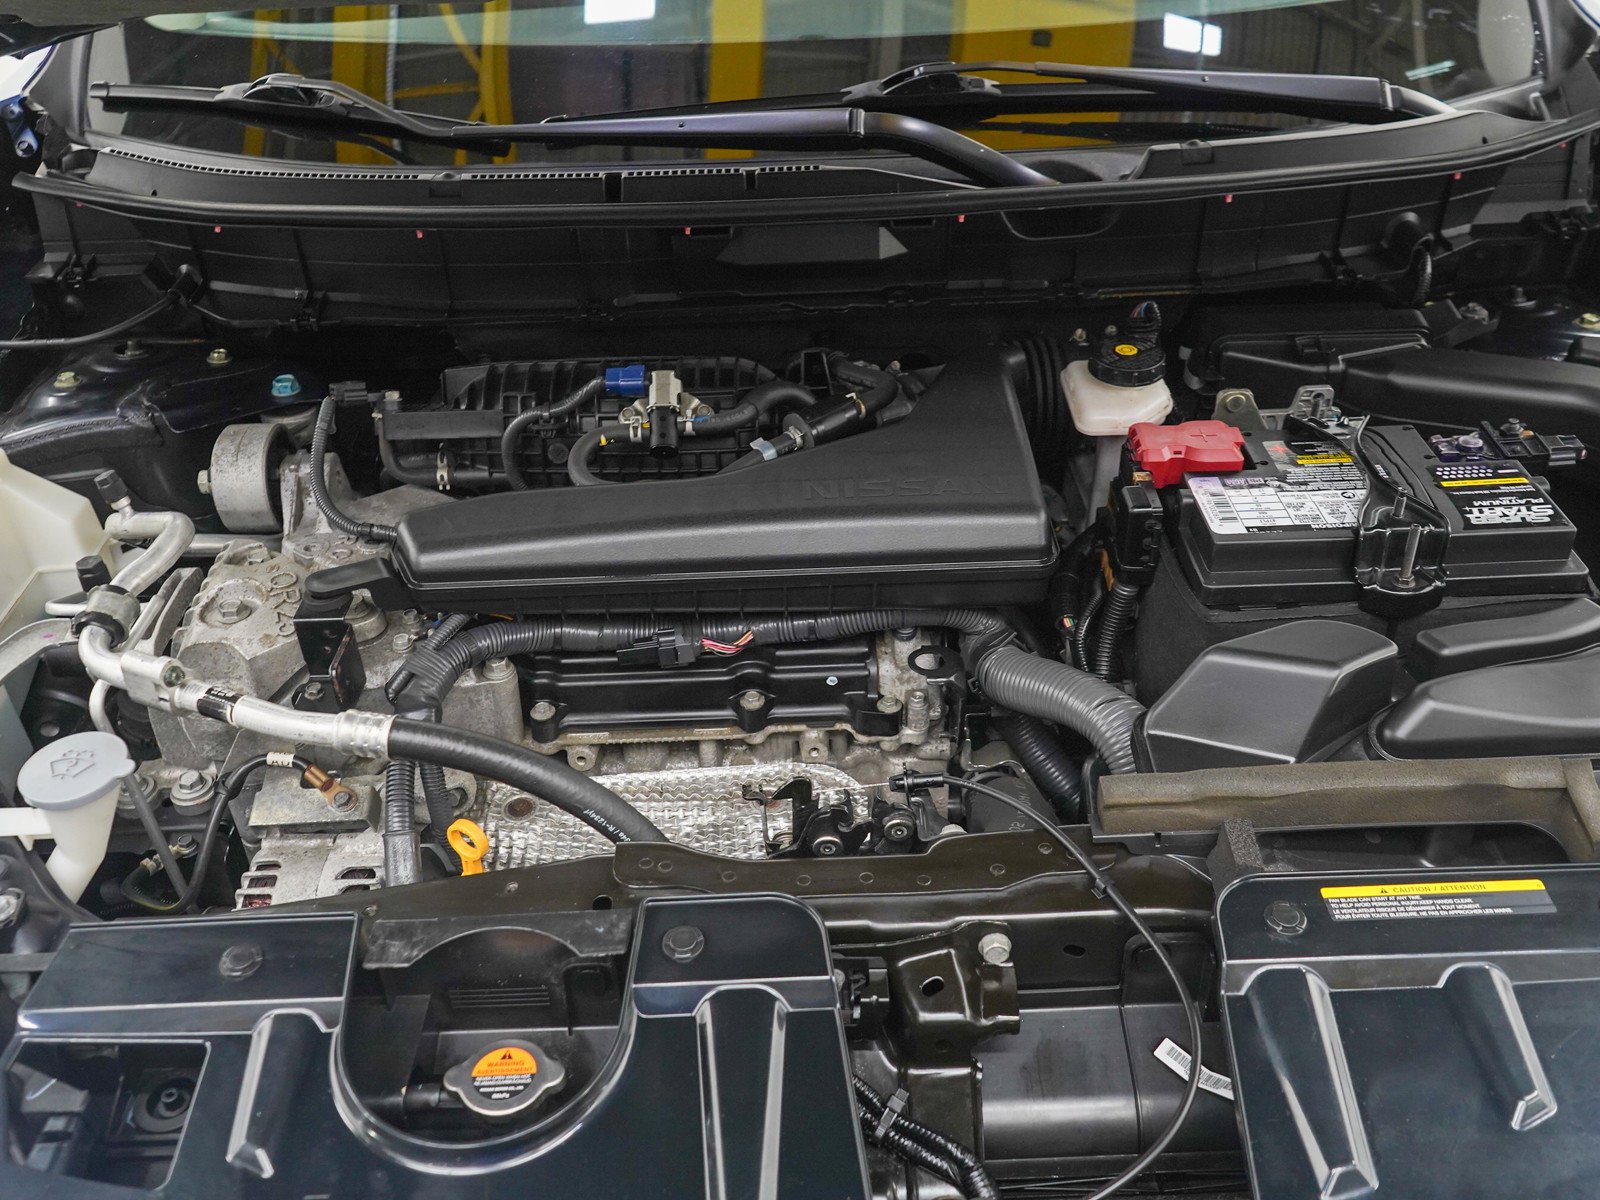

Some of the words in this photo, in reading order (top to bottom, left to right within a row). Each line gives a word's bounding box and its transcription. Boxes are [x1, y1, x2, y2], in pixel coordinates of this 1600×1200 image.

[801, 479, 1009, 500] NISSAN
[1473, 497, 1544, 506] PLATINUM
[1470, 504, 1555, 517] START
[1464, 514, 1551, 525] SUPER
[1393, 885, 1431, 893] CAUTION
